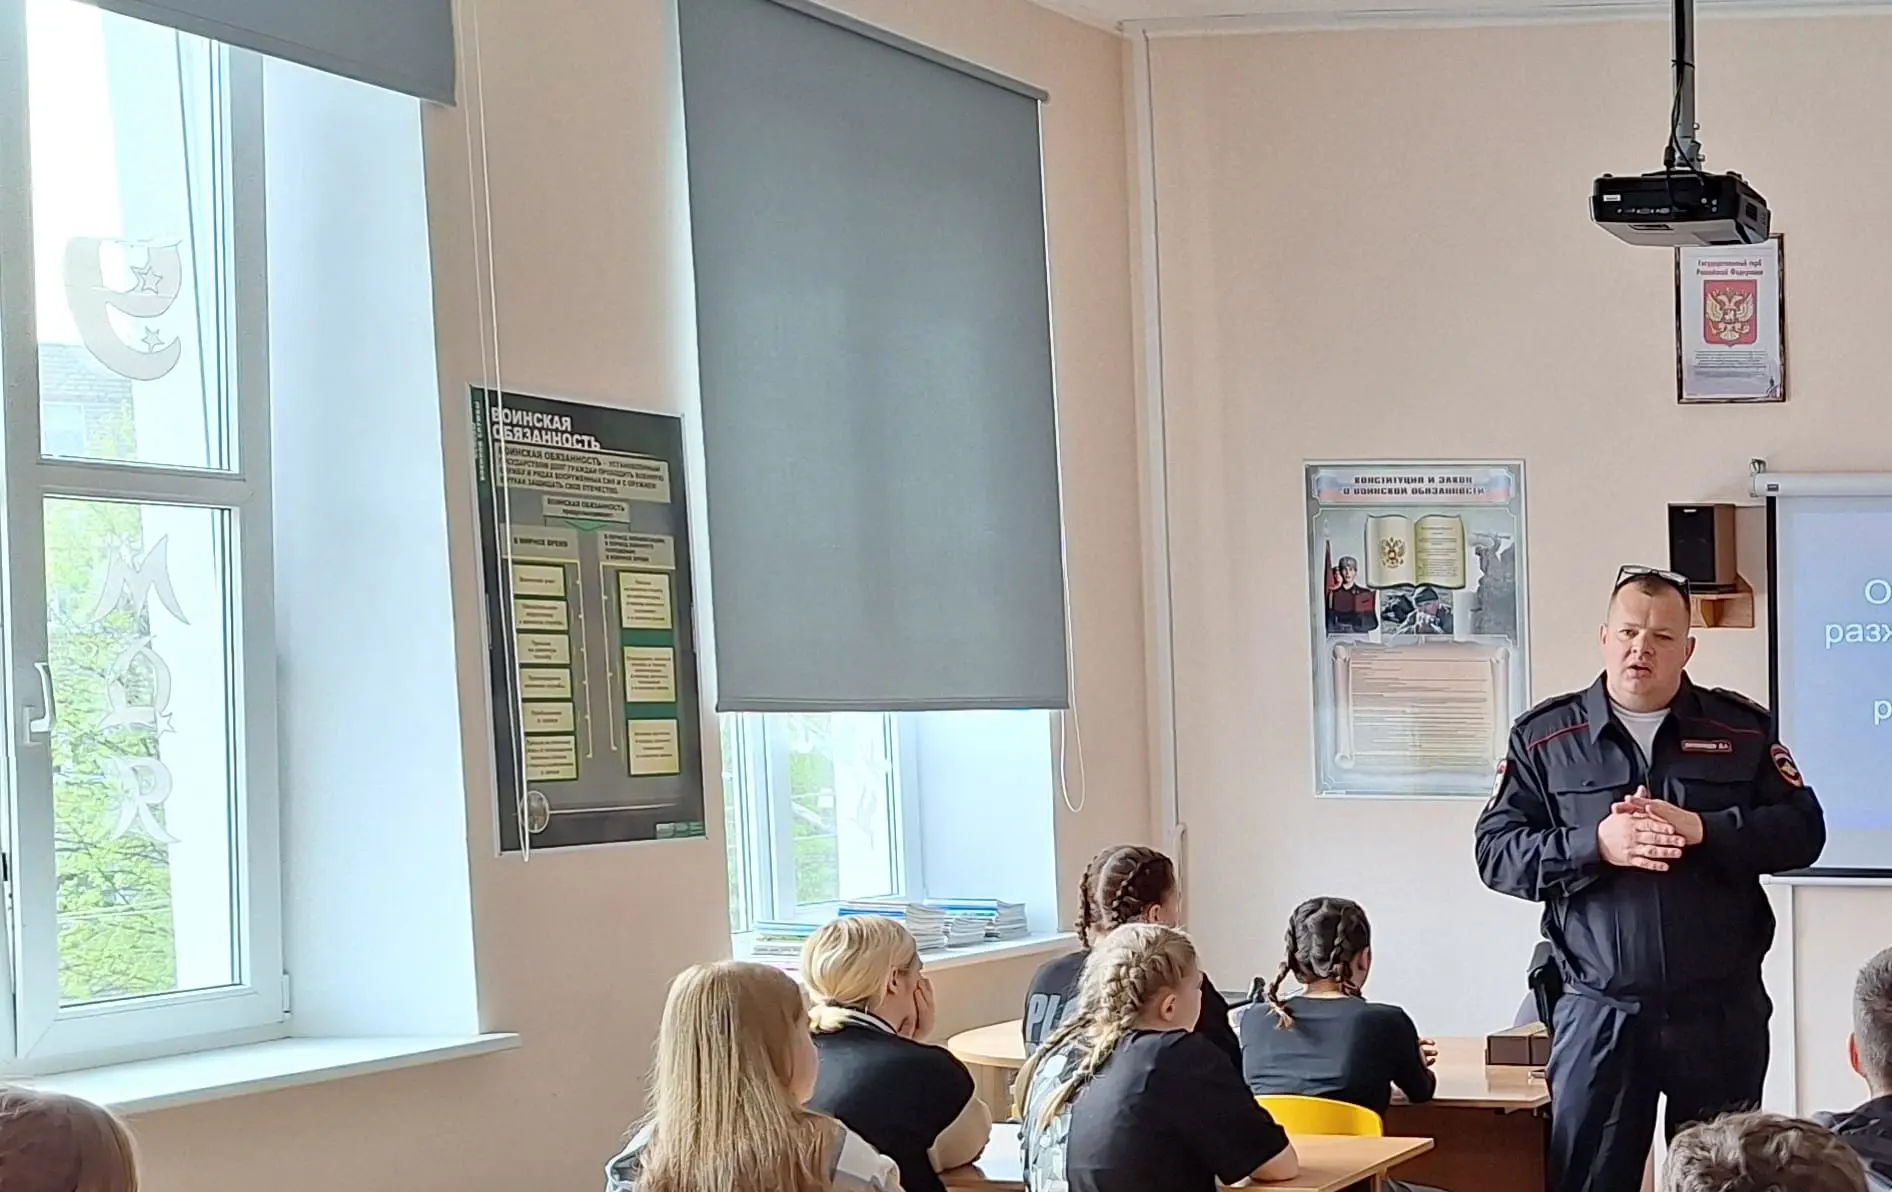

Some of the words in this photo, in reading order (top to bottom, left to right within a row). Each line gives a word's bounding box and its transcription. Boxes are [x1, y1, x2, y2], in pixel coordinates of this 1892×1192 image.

[491, 406, 572, 432] ВОИНСКАЯ
[492, 424, 601, 450] ОБЯЗАННОСТЬ
[1354, 476, 1424, 485] КОНСТИТУЦИЯ
[1428, 476, 1435, 484] И
[1439, 476, 1472, 484] ЗАКОН
[1354, 486, 1408, 495] ВОИНСКОЙ
[1411, 486, 1485, 495] ОБЯЗАННОСТИ
